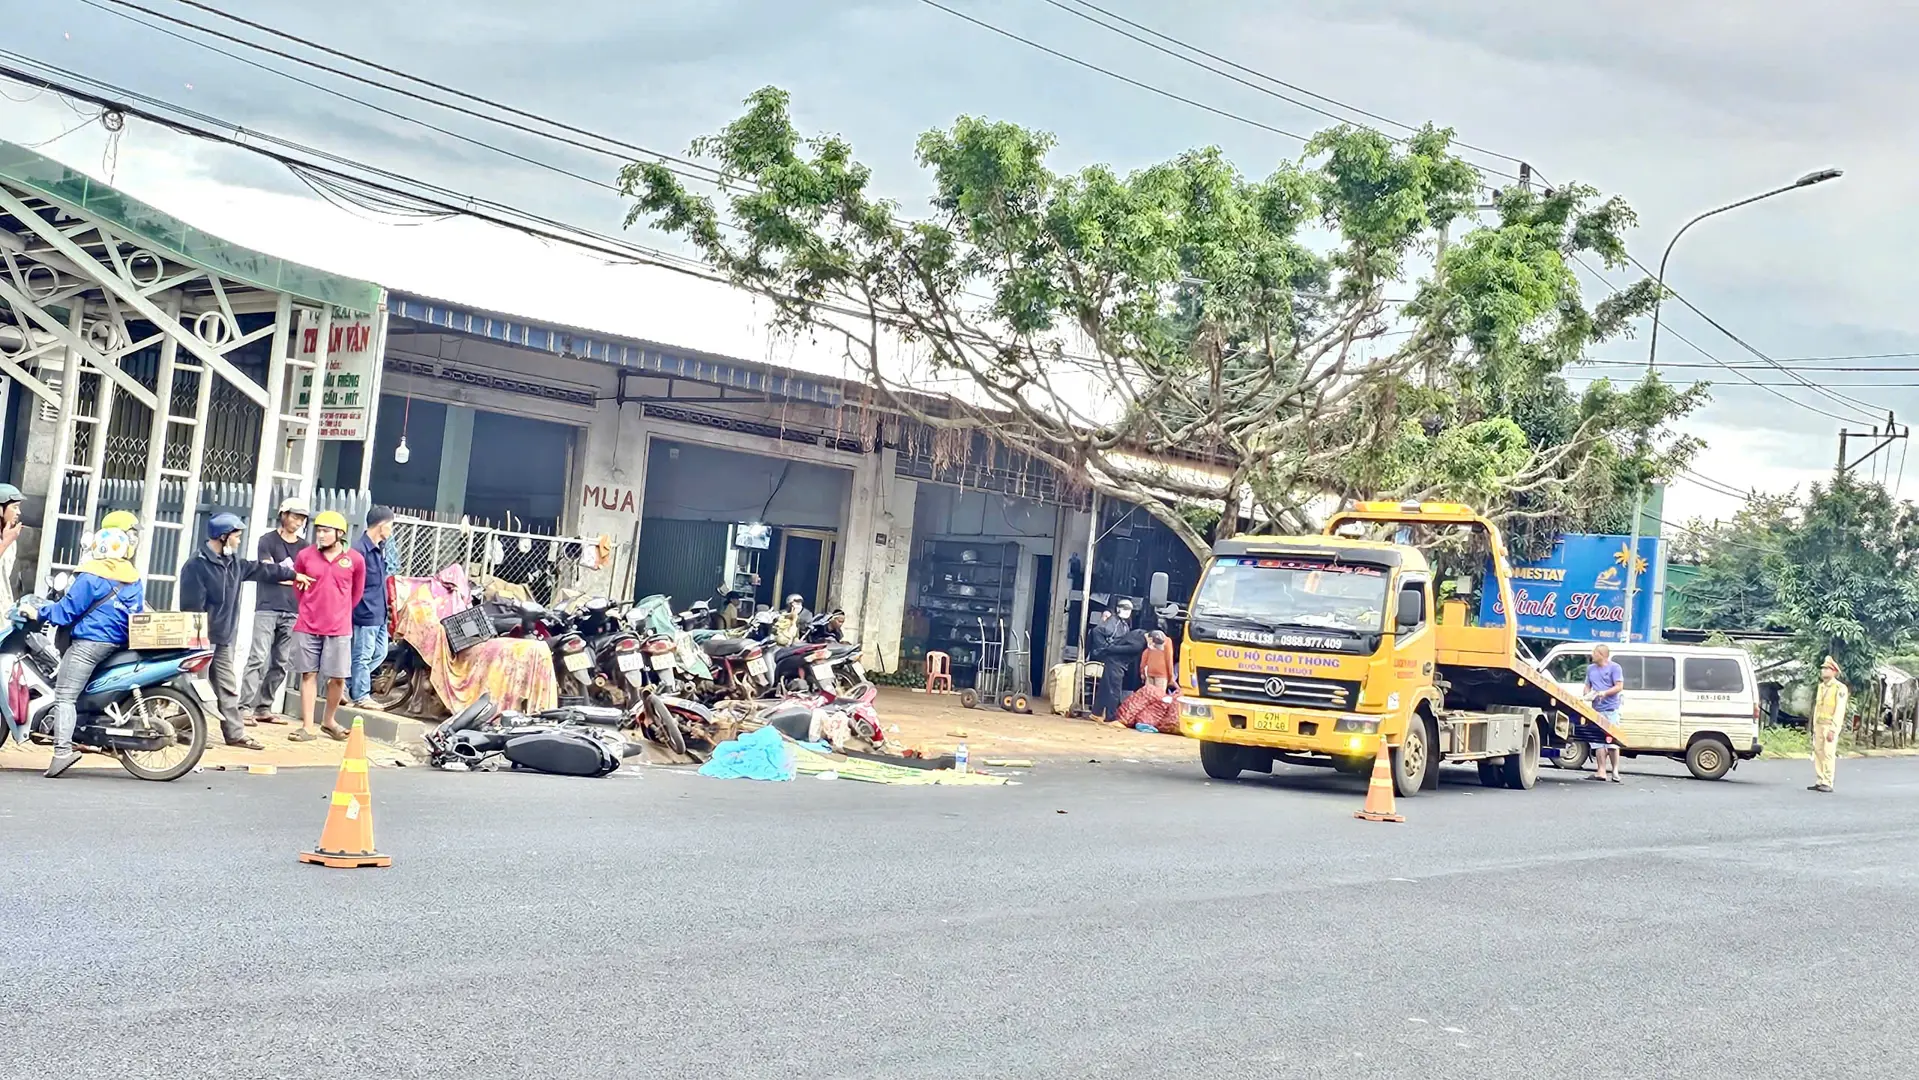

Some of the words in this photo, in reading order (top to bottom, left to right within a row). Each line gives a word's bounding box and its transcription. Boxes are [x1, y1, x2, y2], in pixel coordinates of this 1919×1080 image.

[583, 484, 635, 514] MUA
[1495, 566, 1567, 582] OMESTAY
[1265, 653, 1293, 664] GIAO
